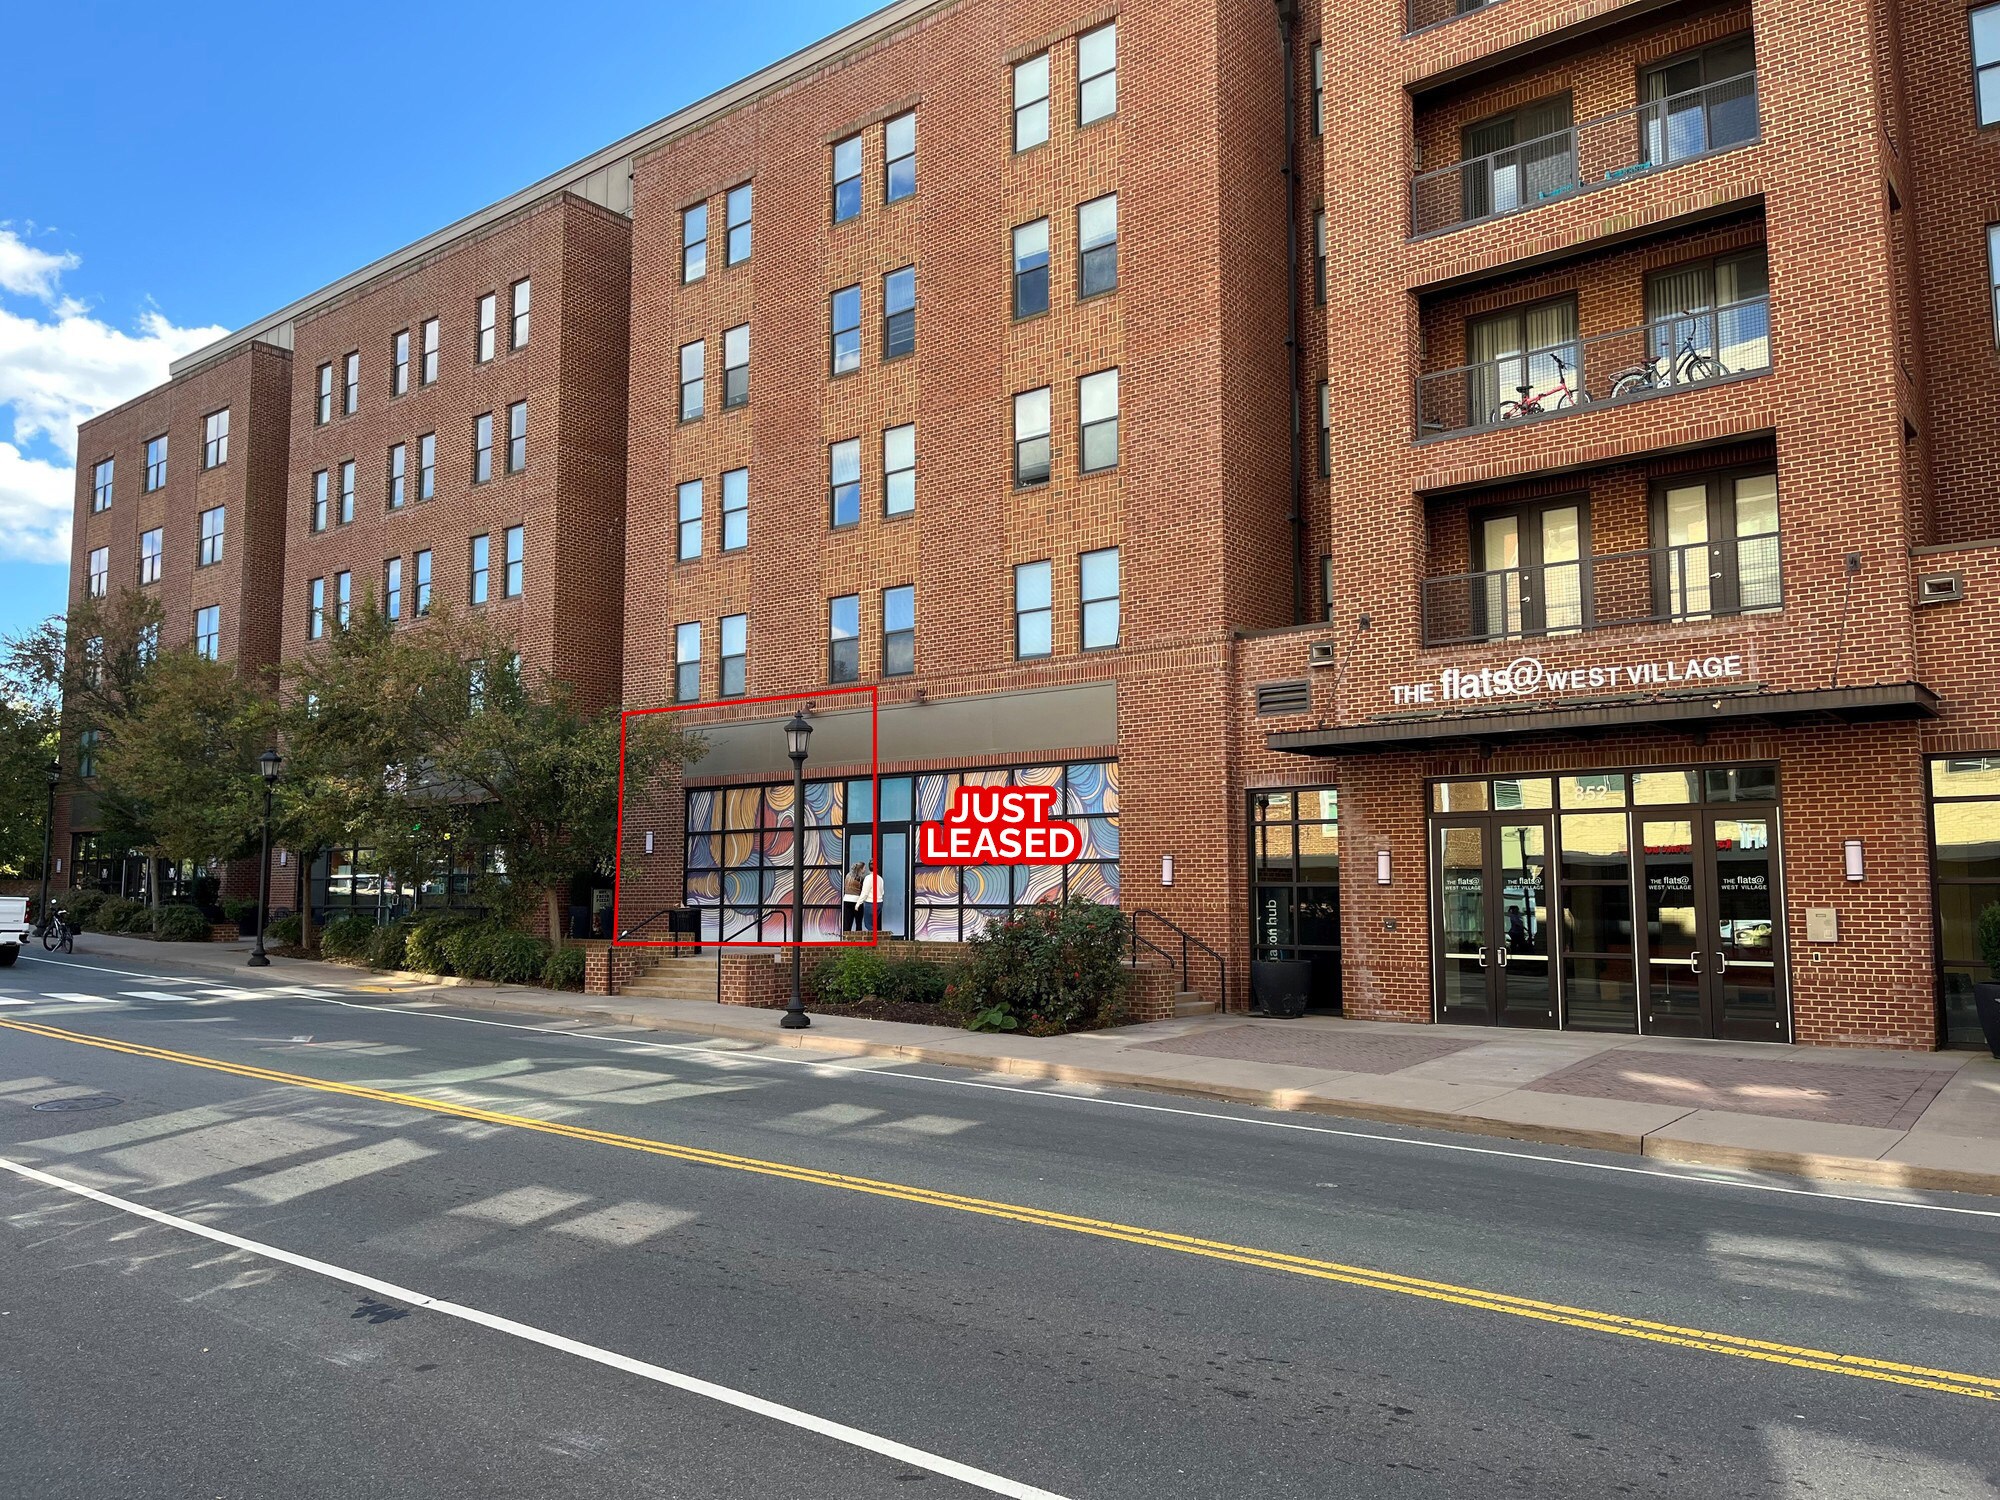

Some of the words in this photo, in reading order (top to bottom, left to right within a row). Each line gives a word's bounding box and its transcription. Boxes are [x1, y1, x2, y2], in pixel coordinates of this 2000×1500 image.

[1390, 684, 1434, 704] THE
[1440, 657, 1542, 700] flats@
[1546, 667, 1621, 691] WEST
[1626, 655, 1742, 686] VILLAGE
[1576, 785, 1607, 800] 852
[1265, 899, 1277, 925] hub
